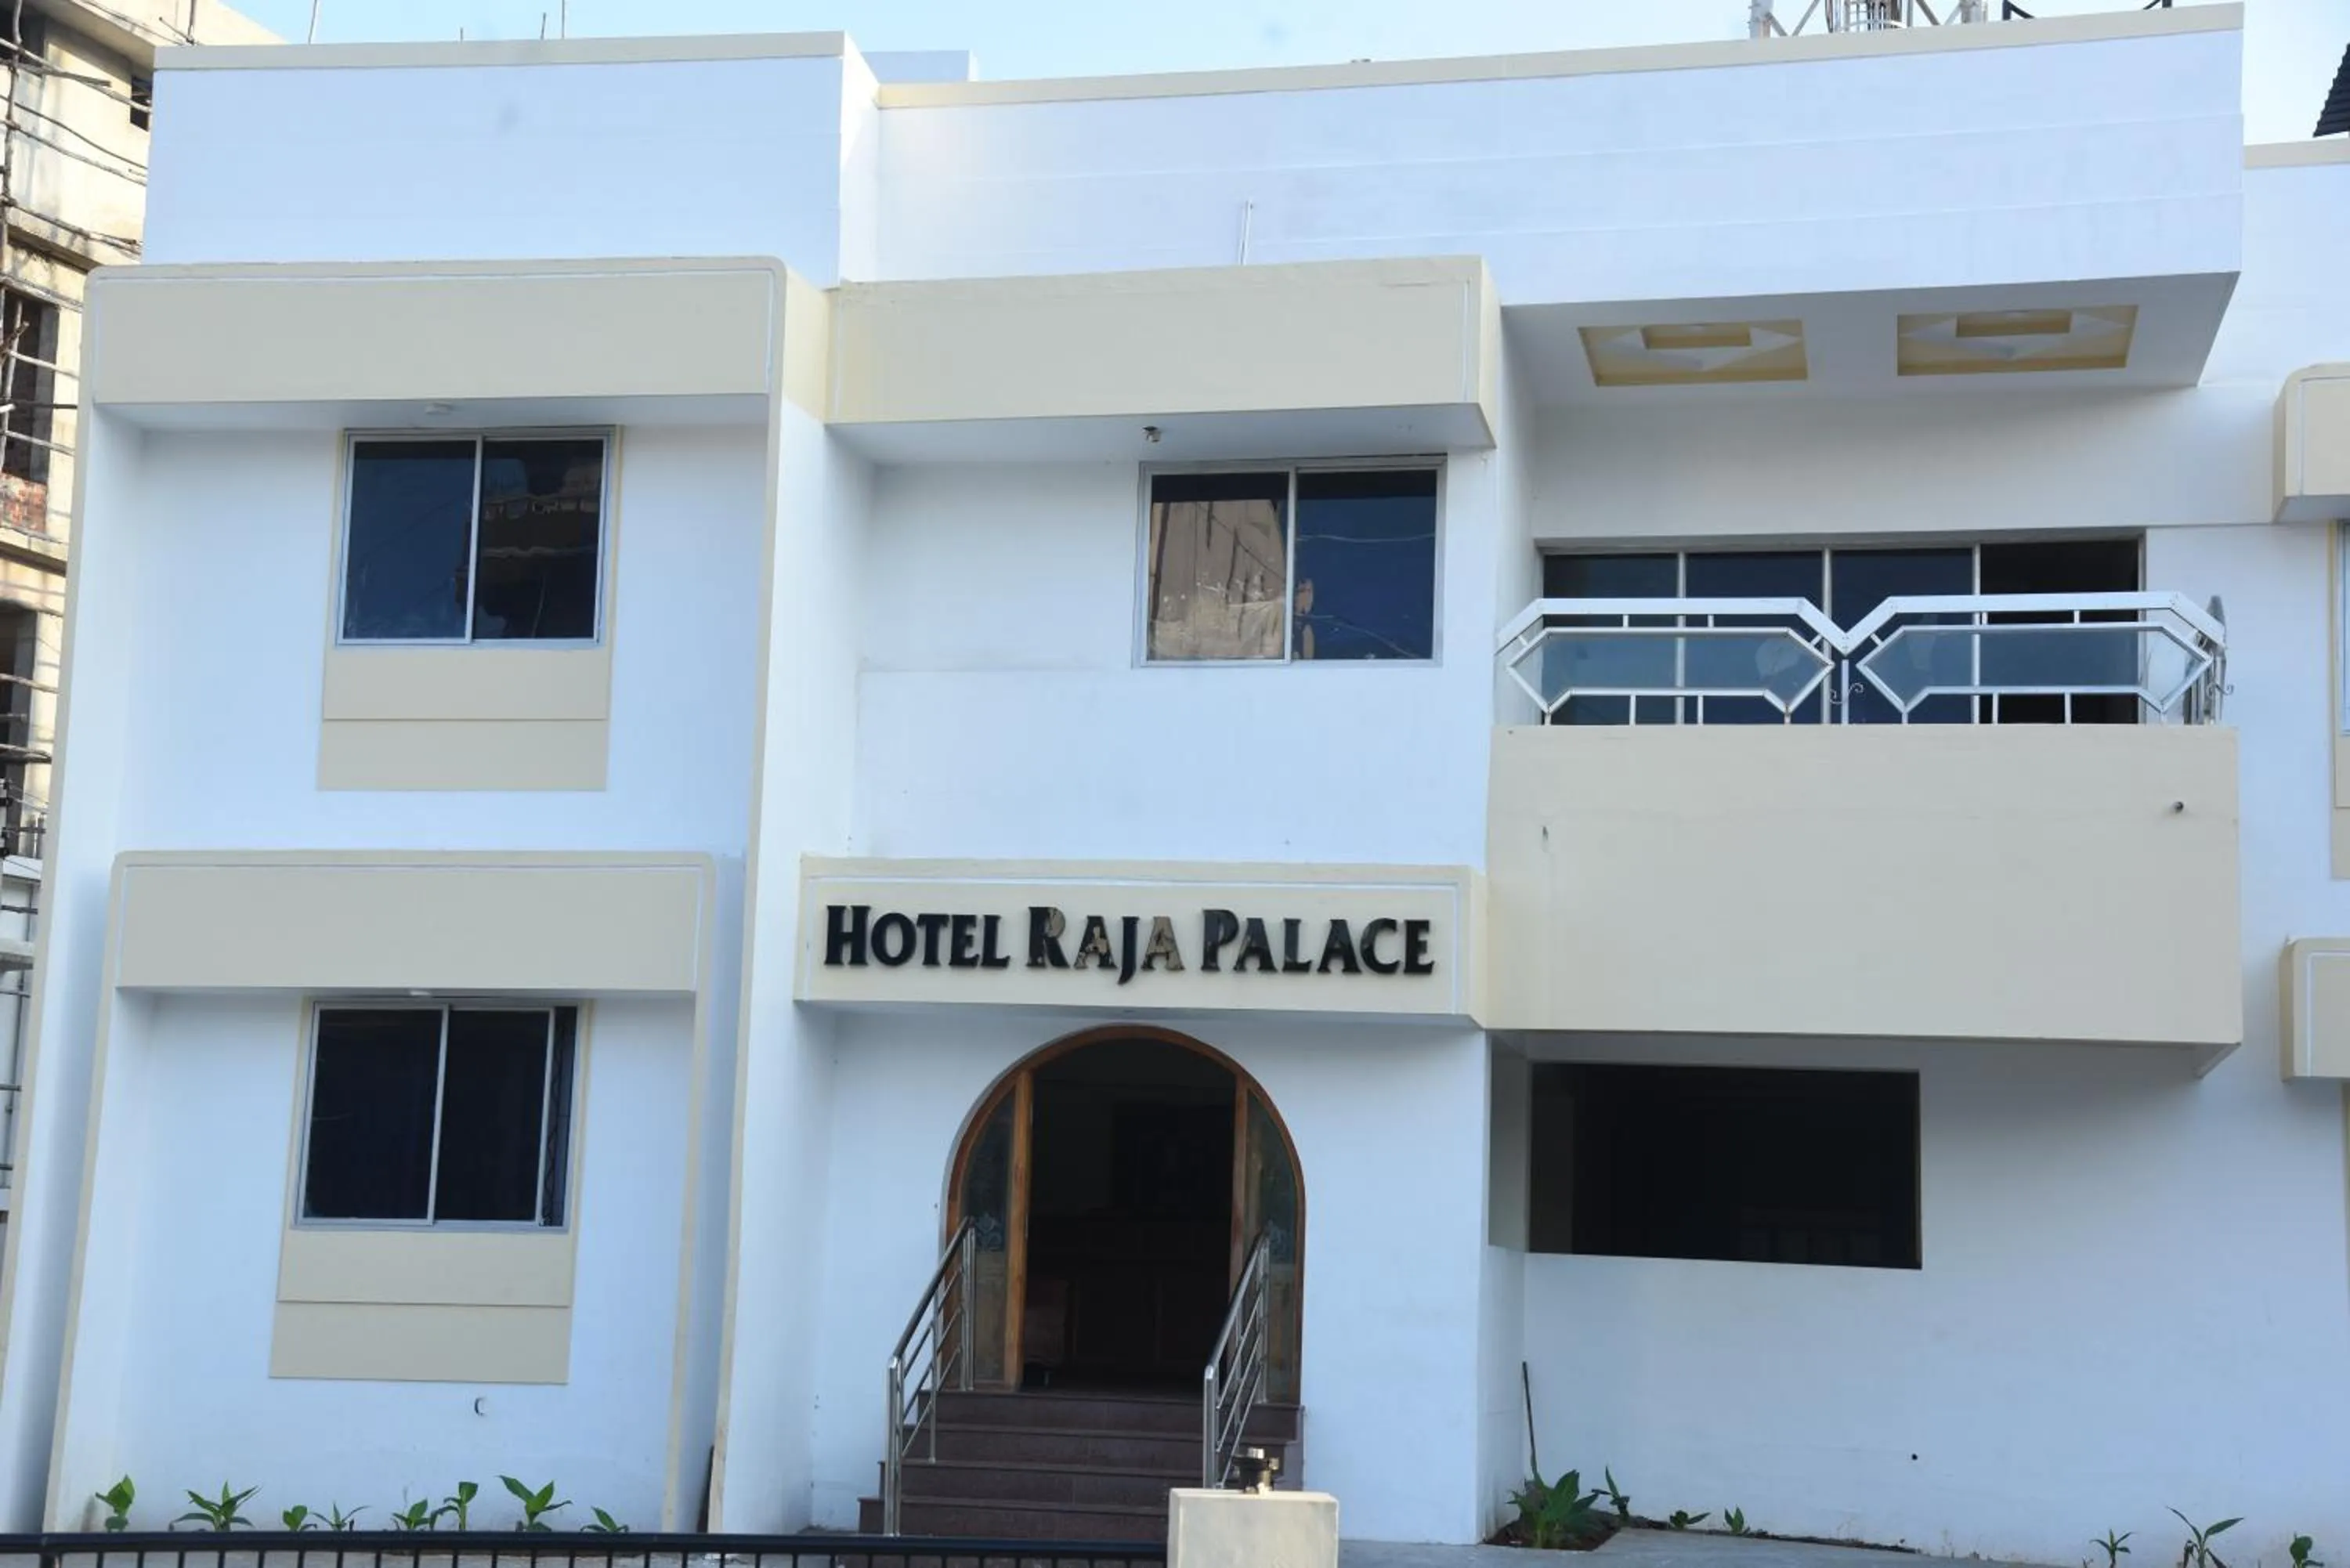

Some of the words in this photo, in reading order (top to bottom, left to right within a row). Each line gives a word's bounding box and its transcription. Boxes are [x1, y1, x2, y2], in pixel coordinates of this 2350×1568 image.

[824, 905, 1010, 970] HOTEL
[1026, 906, 1185, 986] RAJA
[1200, 909, 1436, 977] PALACE
